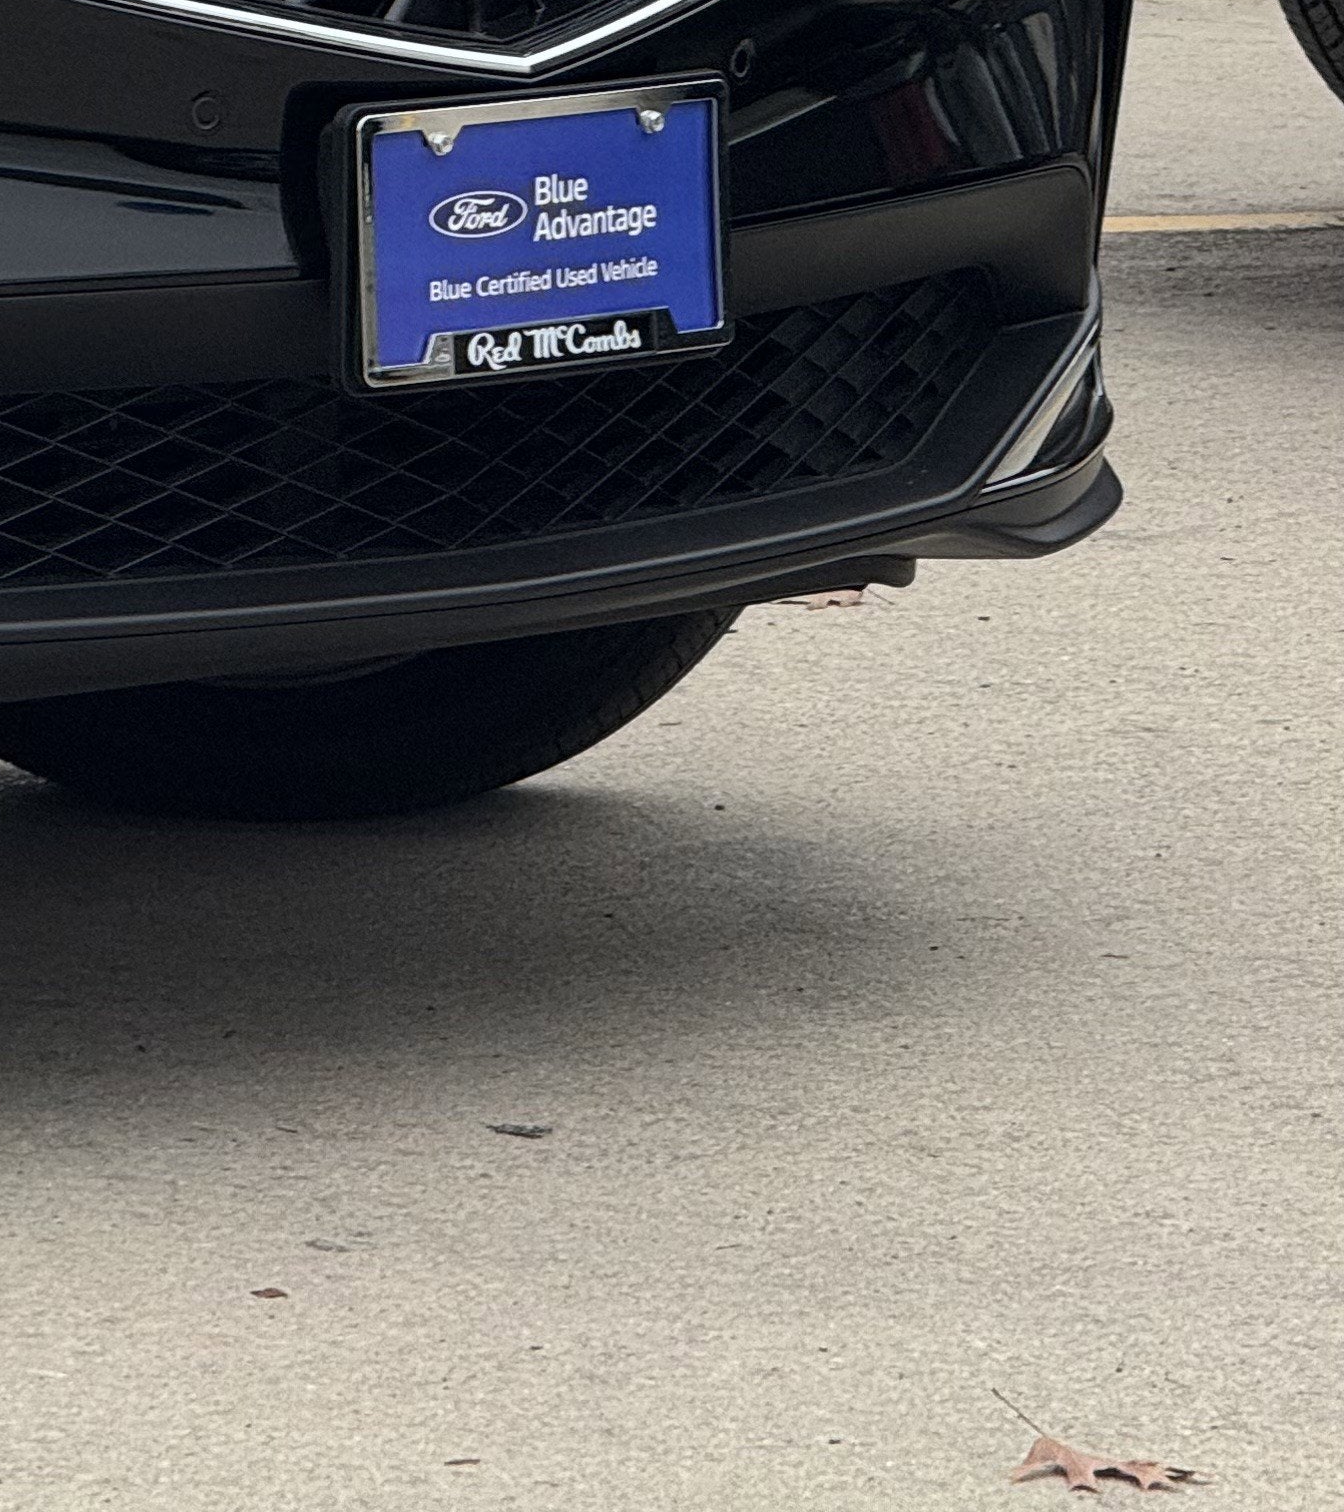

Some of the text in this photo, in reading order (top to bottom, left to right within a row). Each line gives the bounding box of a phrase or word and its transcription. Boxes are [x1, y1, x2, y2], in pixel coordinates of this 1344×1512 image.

[534, 174, 589, 205] Blue
[447, 197, 510, 232] Ford
[532, 204, 658, 242] Advantage
[429, 256, 658, 302] Blue Certified Used Vehicle
[467, 320, 642, 370] Red McCombs
